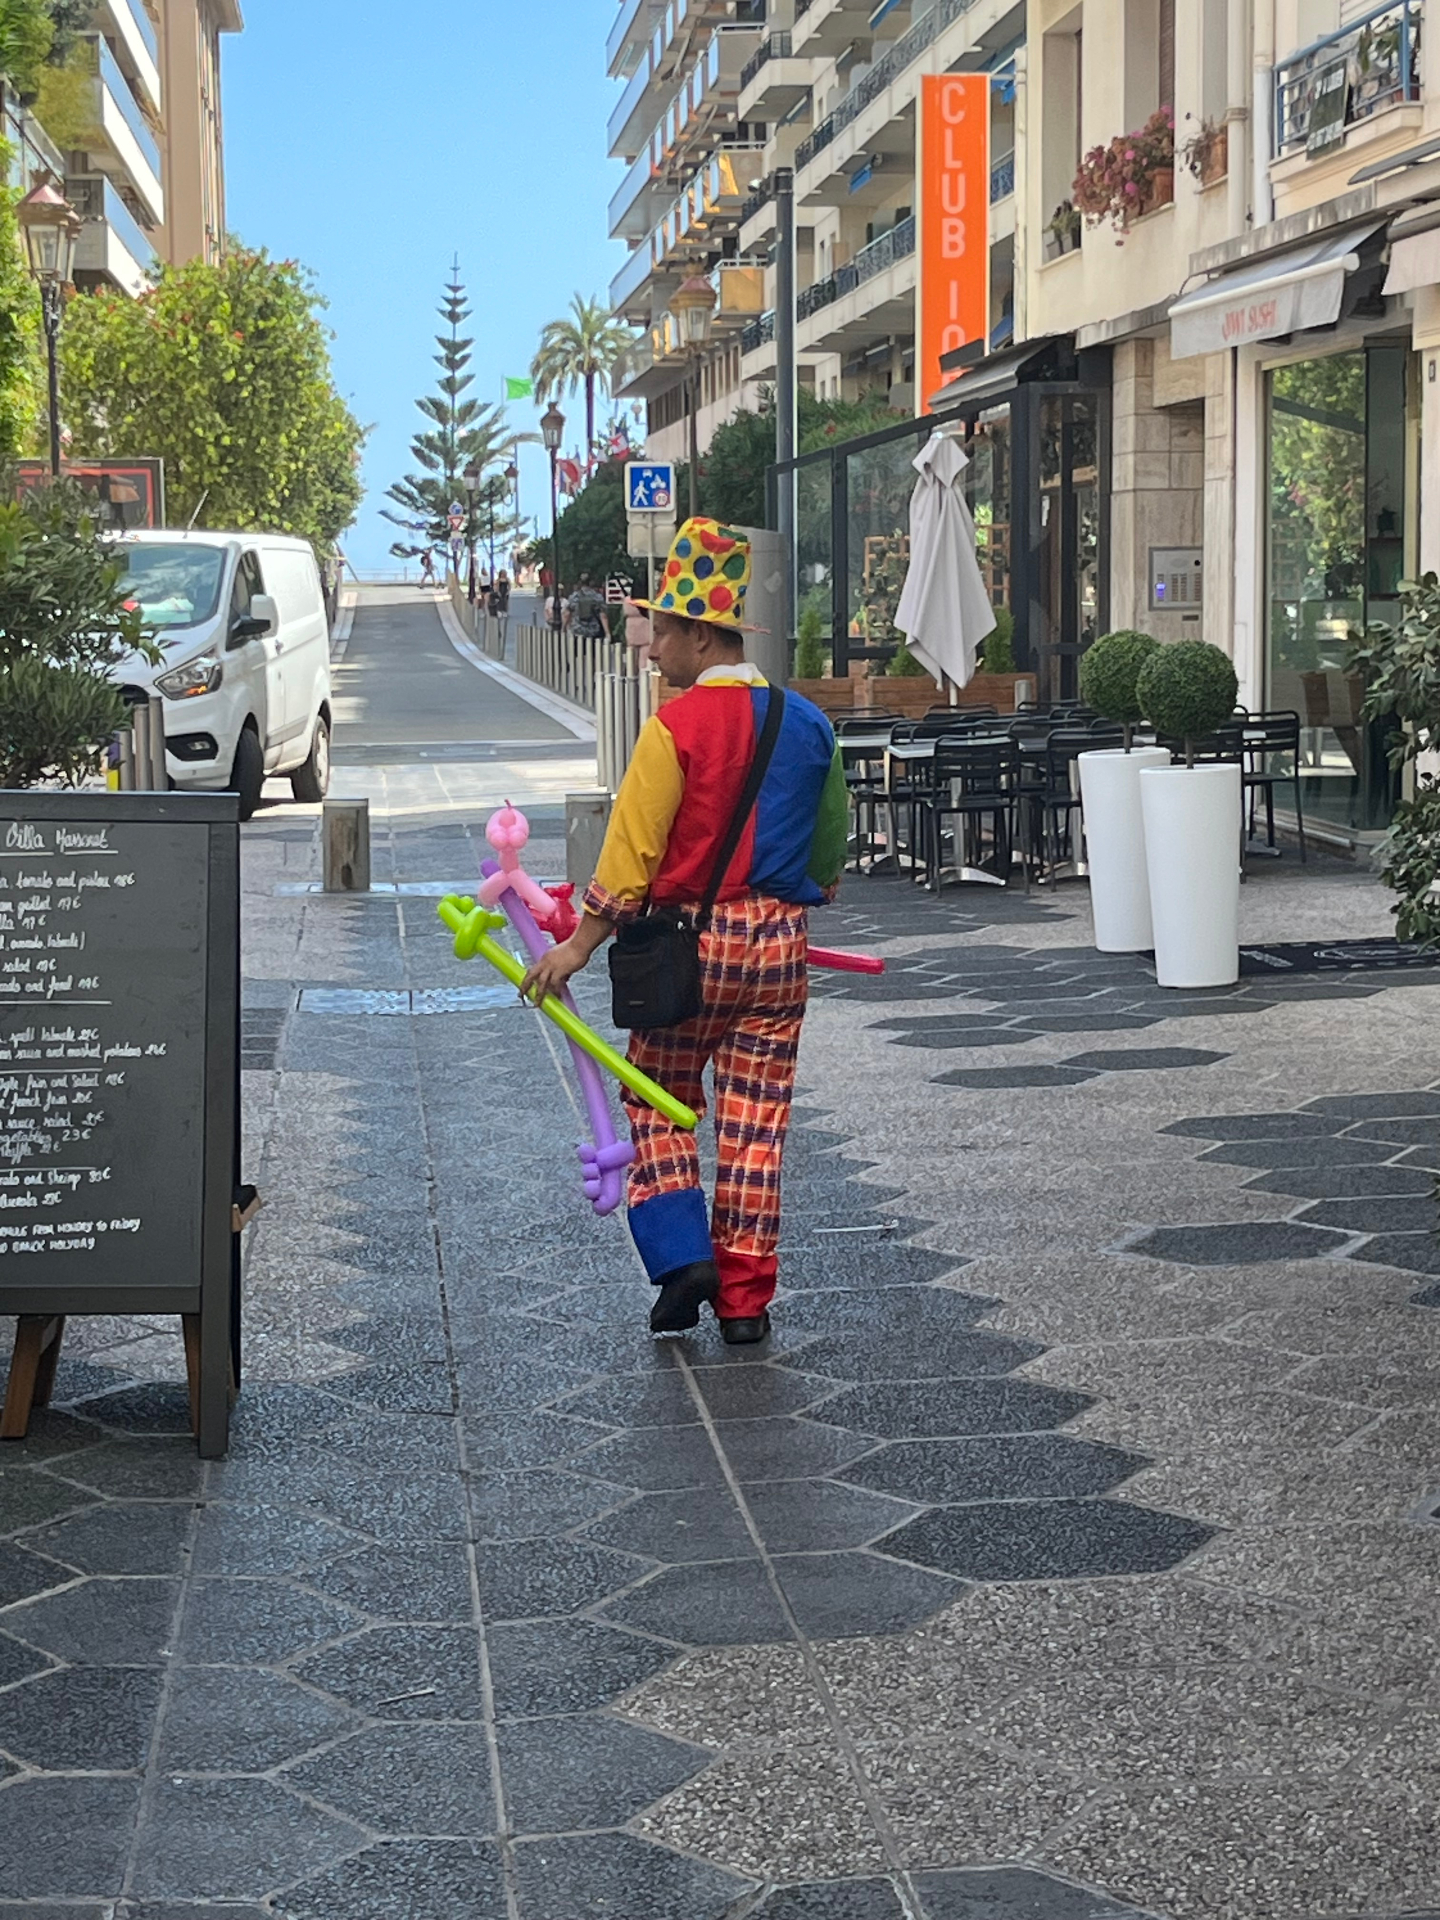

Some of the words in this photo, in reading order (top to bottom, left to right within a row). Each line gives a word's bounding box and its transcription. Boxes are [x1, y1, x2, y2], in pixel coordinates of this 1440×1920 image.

[941, 82, 966, 259] CLUB
[56, 870, 77, 888] and
[25, 978, 45, 992] and
[45, 1043, 65, 1058] and
[50, 1075, 69, 1088] and
[62, 1128, 92, 1142] 23€
[24, 1171, 45, 1186] and
